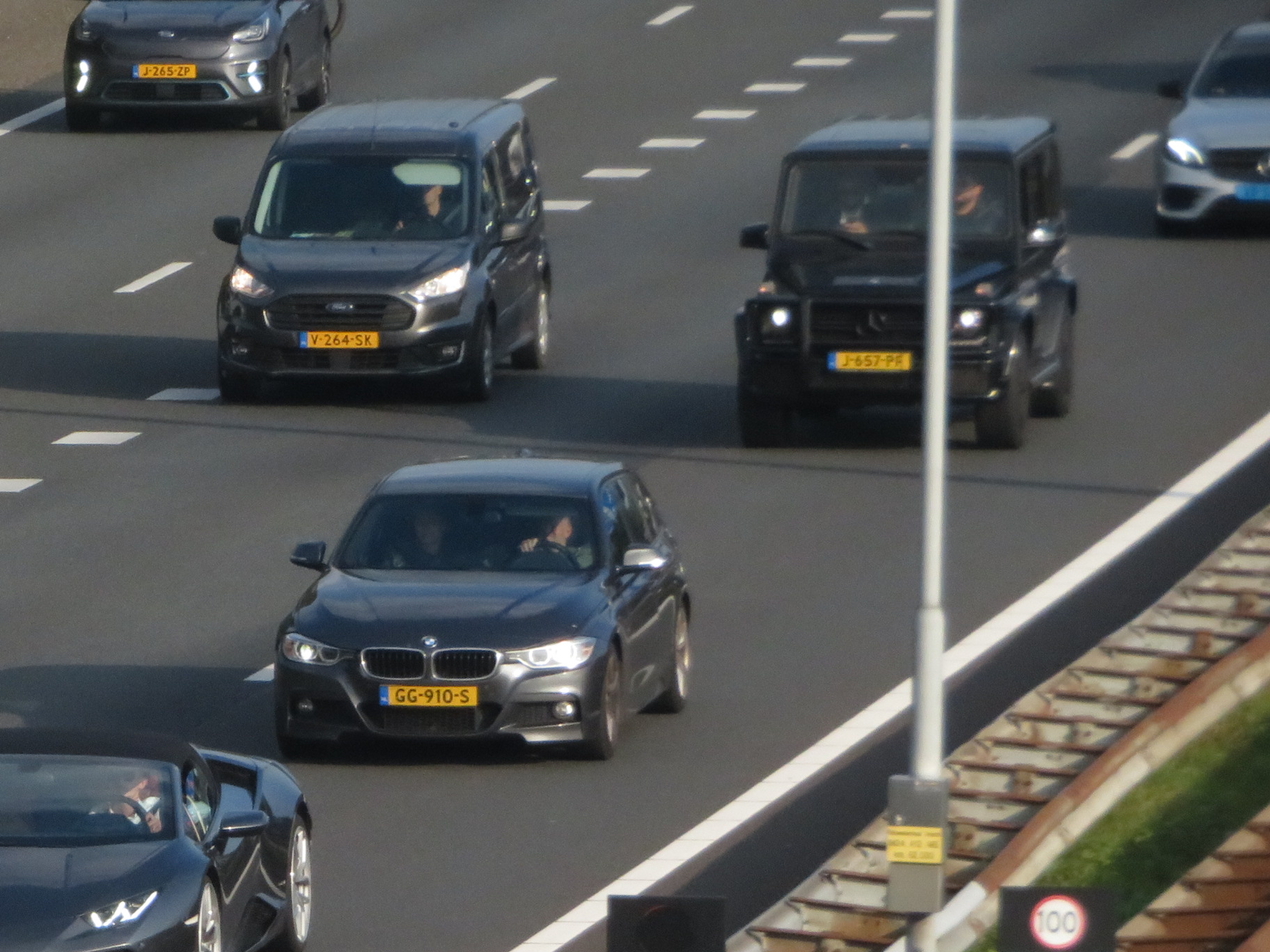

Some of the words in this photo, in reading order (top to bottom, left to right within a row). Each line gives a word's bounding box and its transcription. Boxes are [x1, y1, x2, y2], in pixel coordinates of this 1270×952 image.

[142, 66, 191, 77] J-265-ZP
[310, 334, 373, 347] V-264-SK
[394, 688, 470, 704] GG-910-S
[1037, 910, 1078, 934] 100
